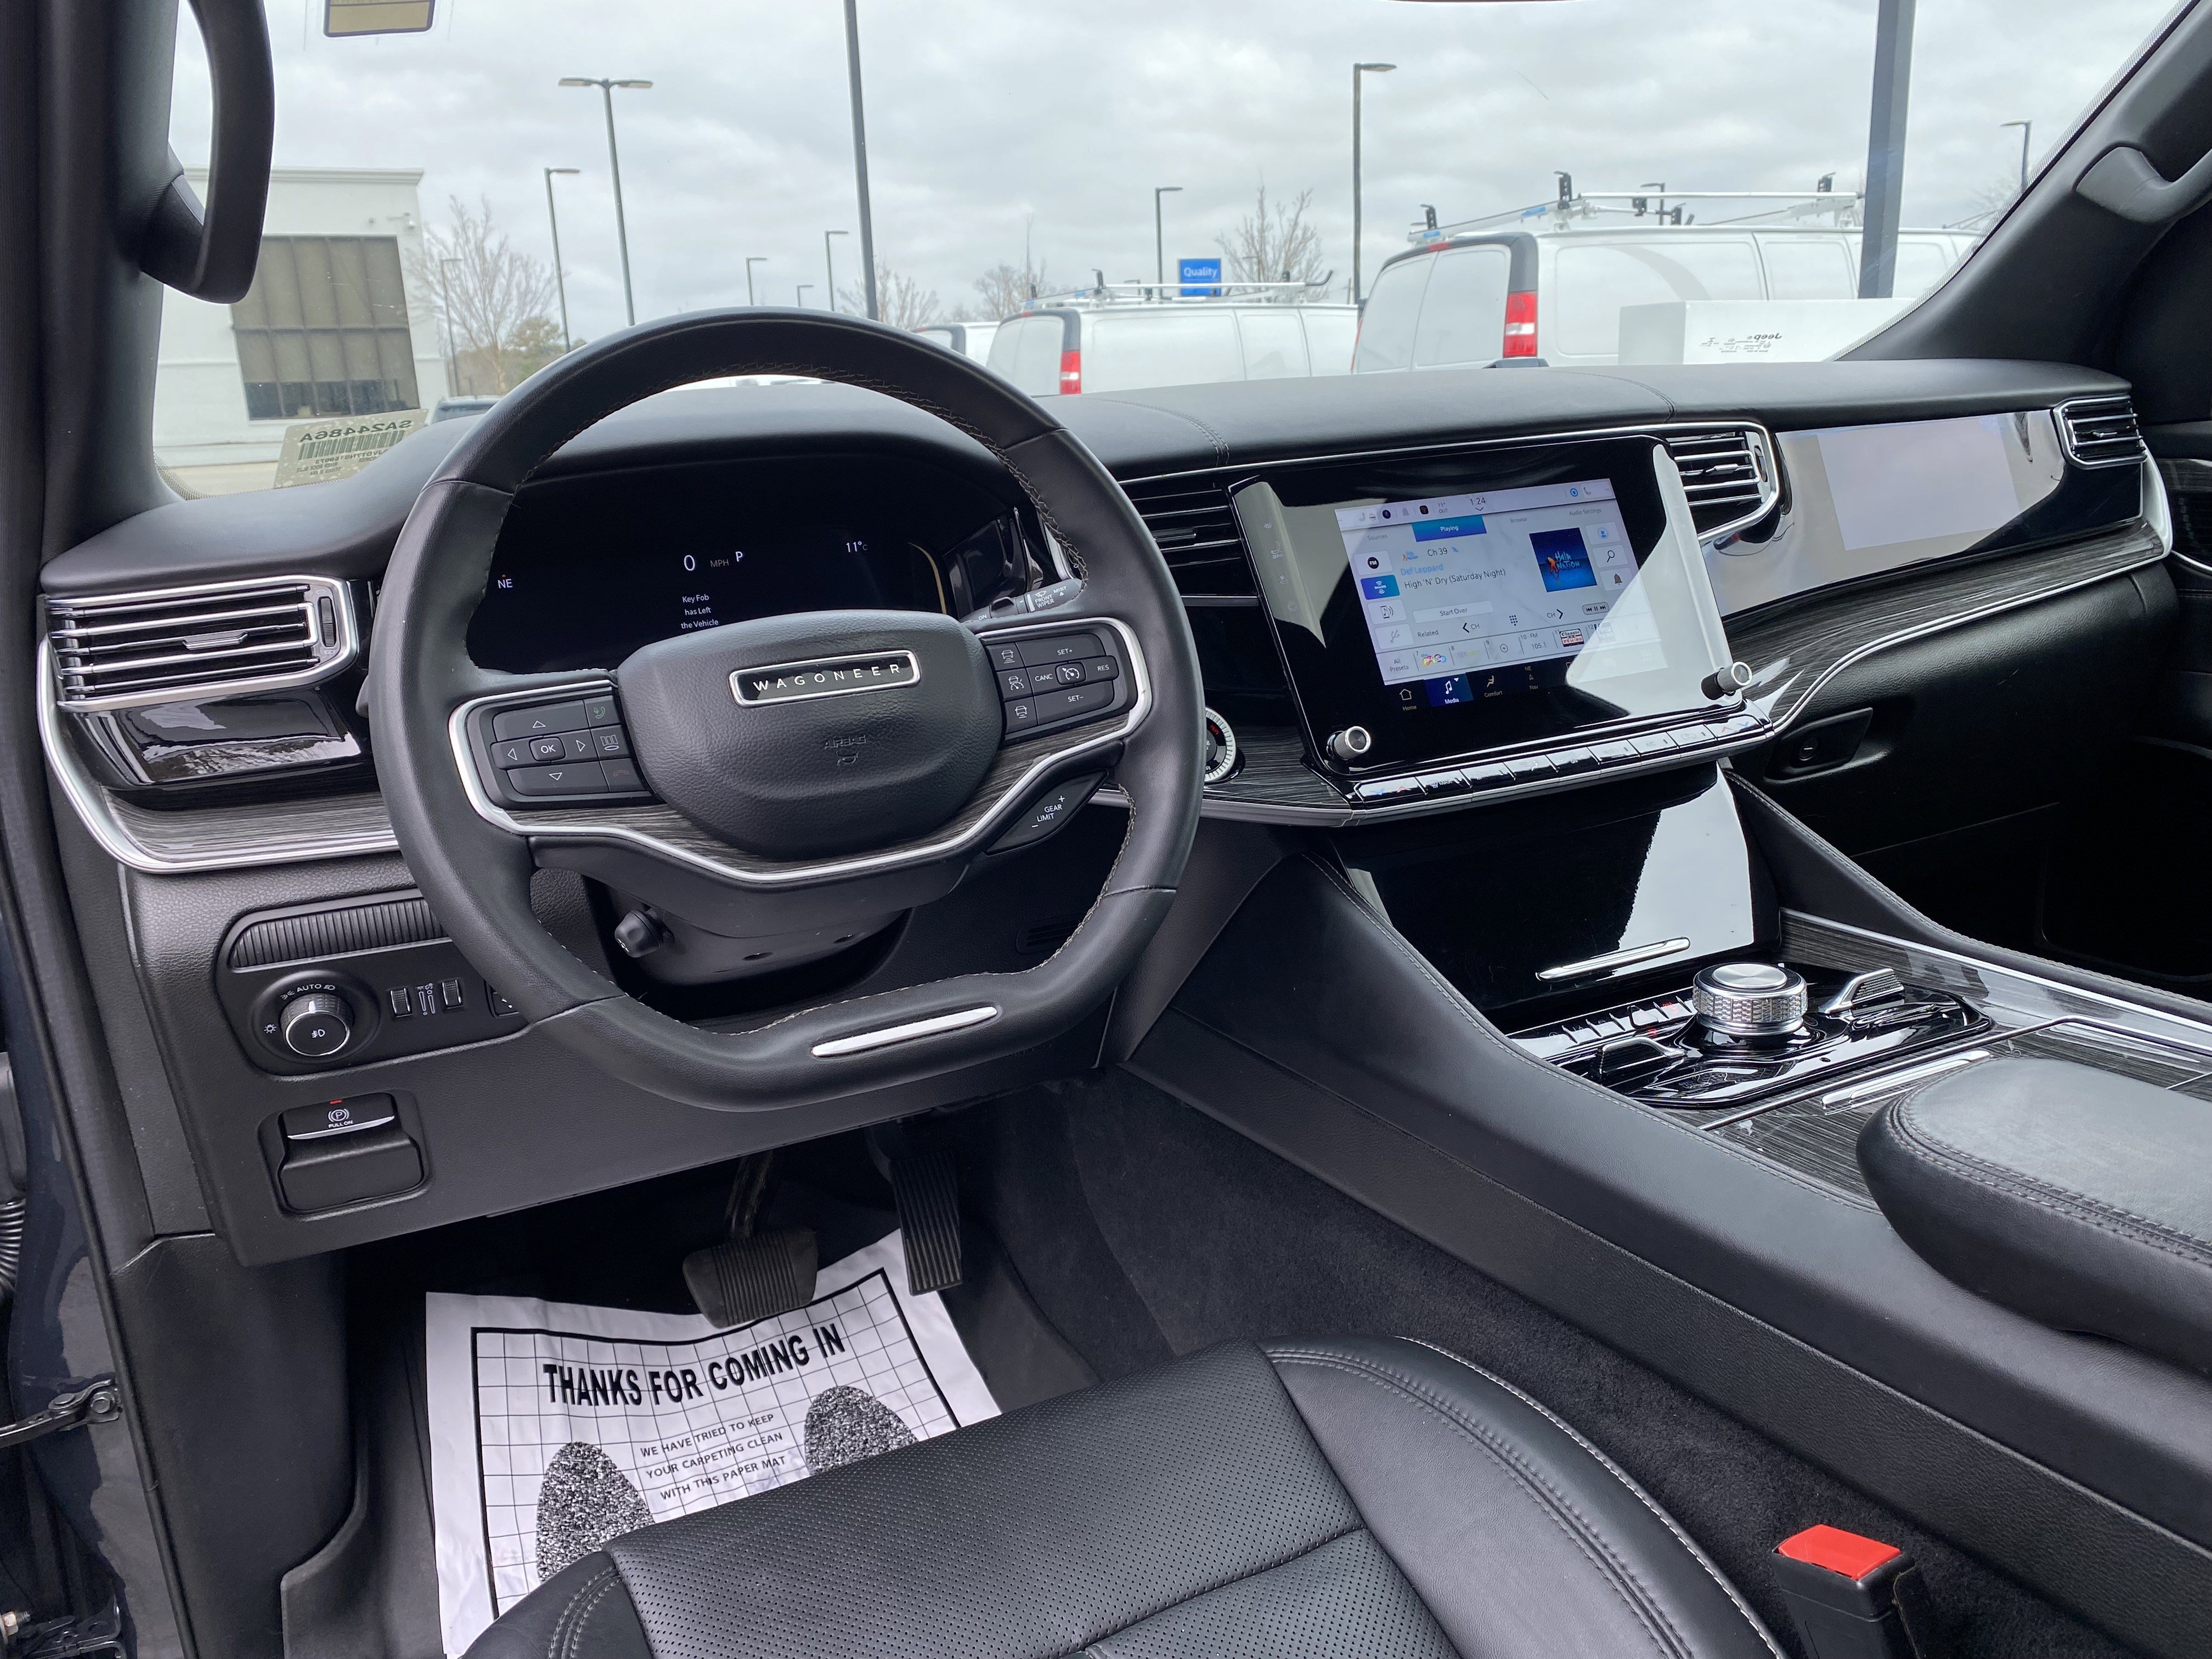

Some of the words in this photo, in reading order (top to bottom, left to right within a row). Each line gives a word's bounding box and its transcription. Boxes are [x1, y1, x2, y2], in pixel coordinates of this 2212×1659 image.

[1184, 267, 1217, 278] Quality
[1470, 497, 1486, 505] 1:24
[1583, 507, 1602, 516] Settings
[684, 555, 695, 571] 0
[710, 559, 729, 568] MPH
[735, 551, 743, 562] P
[1555, 551, 1572, 562] HAIR
[1400, 567, 1413, 575] Def
[1414, 563, 1444, 574] Leppard
[1556, 561, 1580, 571] NATION
[1404, 580, 1422, 589] High
[1435, 577, 1448, 585] Dry
[1449, 572, 1482, 583] (Saturday
[1483, 568, 1506, 578] Night)
[498, 579, 513, 589] NE
[1035, 594, 1053, 603] FRONT
[1036, 599, 1054, 608] WIPER
[693, 619, 719, 628] Vehicle
[753, 664, 900, 692] WAGONEER
[824, 735, 867, 750] AIRBAG
[540, 745, 556, 754] OK
[1044, 804, 1062, 813] GEAR
[1037, 813, 1054, 822] LIMIT
[297, 984, 322, 992] AUTO
[543, 1364, 642, 1406] THANKS
[650, 1368, 703, 1405] FOR
[709, 1335, 809, 1390] COMING
[812, 1323, 845, 1358] IN
[640, 1446, 658, 1457] WE
[662, 1437, 692, 1453] HAVE
[694, 1426, 726, 1443] TRIED
[729, 1422, 744, 1432] TO
[748, 1414, 774, 1427] KEEP
[646, 1464, 679, 1479] YOUR
[682, 1443, 744, 1469] CARPETING
[747, 1432, 783, 1448] CLEAN
[660, 1484, 691, 1500] WITH
[693, 1475, 720, 1488] THIS
[723, 1463, 758, 1481] PAPER
[762, 1456, 786, 1469] MAT
